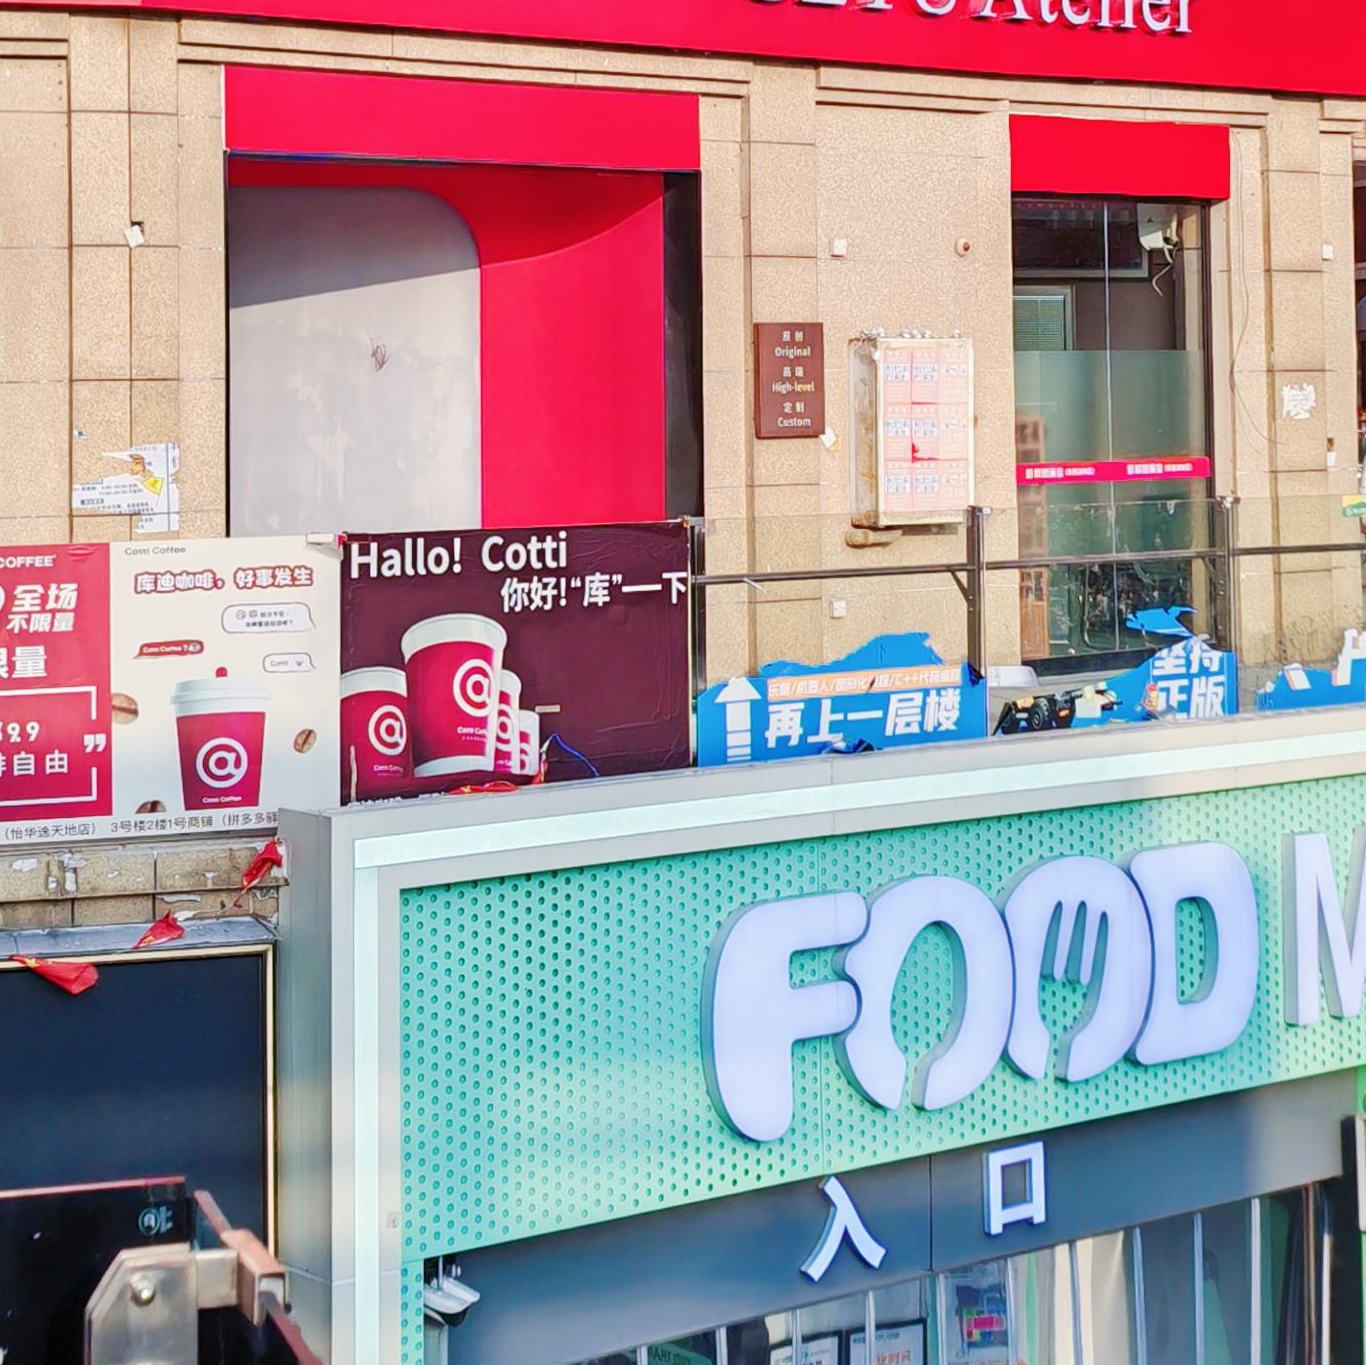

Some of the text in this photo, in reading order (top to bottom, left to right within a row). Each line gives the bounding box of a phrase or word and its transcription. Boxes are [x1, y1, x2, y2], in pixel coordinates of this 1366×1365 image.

[774, 346, 811, 359] Original
[771, 381, 815, 395] High-level
[777, 417, 812, 428] Custom
[124, 545, 187, 556] Cotti Coffee
[349, 530, 568, 580] Hallo! Cotti
[234, 565, 314, 589] 好事发生
[11, 582, 79, 612] 全场
[6, 612, 76, 634] 不限量
[764, 687, 962, 749] 再上一层楼
[703, 839, 1260, 1143] FOOD
[799, 1141, 1050, 1283] 入口
